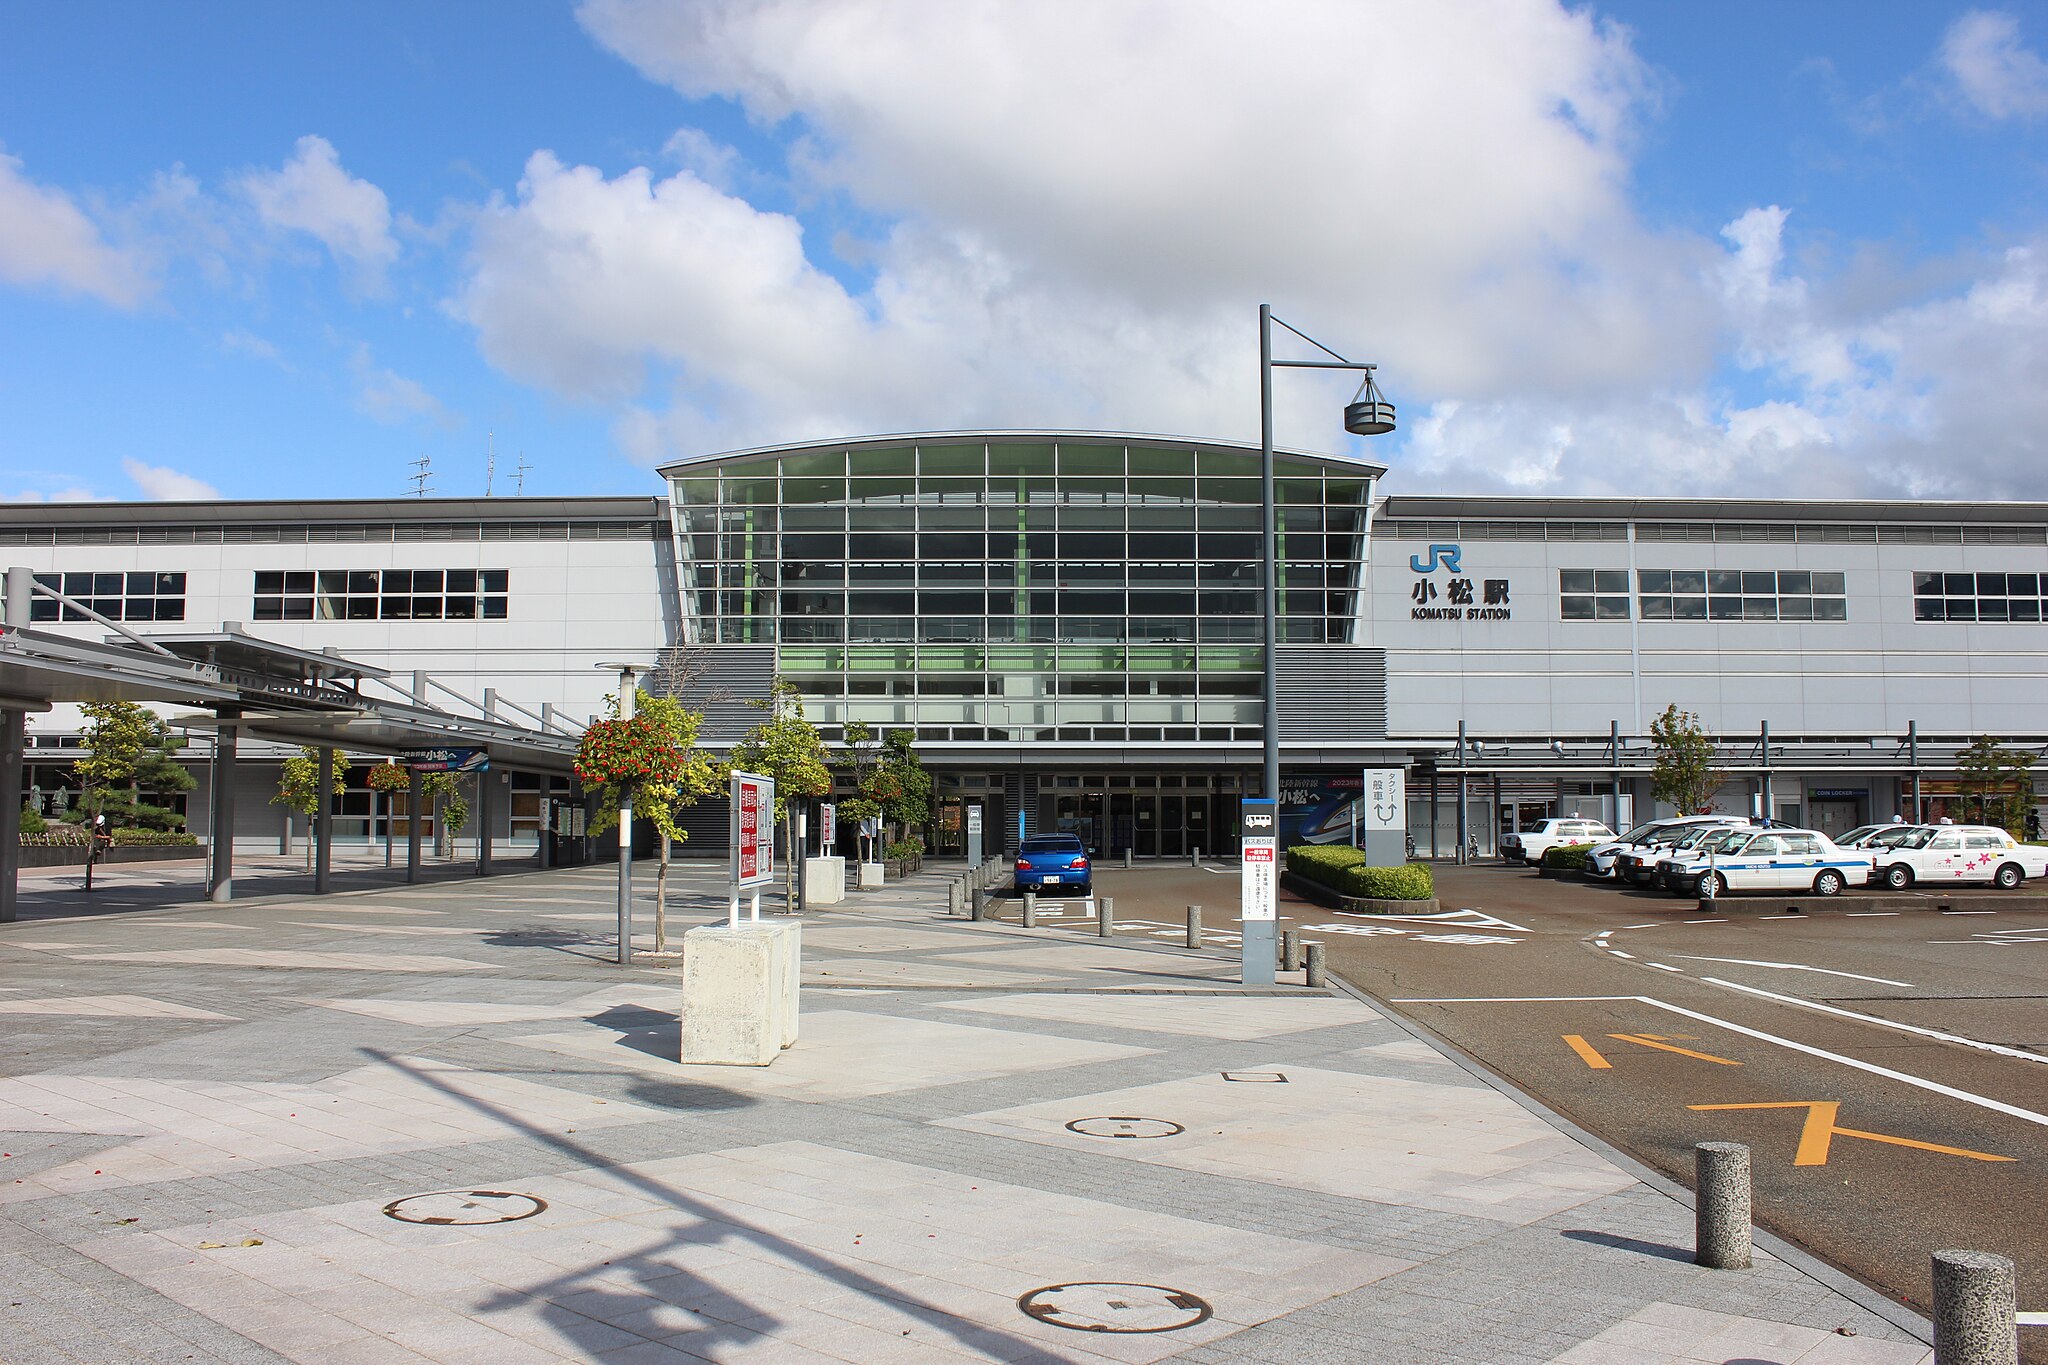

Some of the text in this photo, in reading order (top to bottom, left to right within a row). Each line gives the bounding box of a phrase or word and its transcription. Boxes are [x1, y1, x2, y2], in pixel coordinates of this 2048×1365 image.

[1410, 544, 1461, 573] JR
[1411, 578, 1510, 605] 小松駅
[1411, 608, 1511, 620] KOMATSU STATION
[426, 750, 457, 761] 小松へ
[1279, 789, 1320, 805] 小松へ
[1373, 772, 1383, 801] 一般車
[1388, 773, 1397, 802] タクシー
